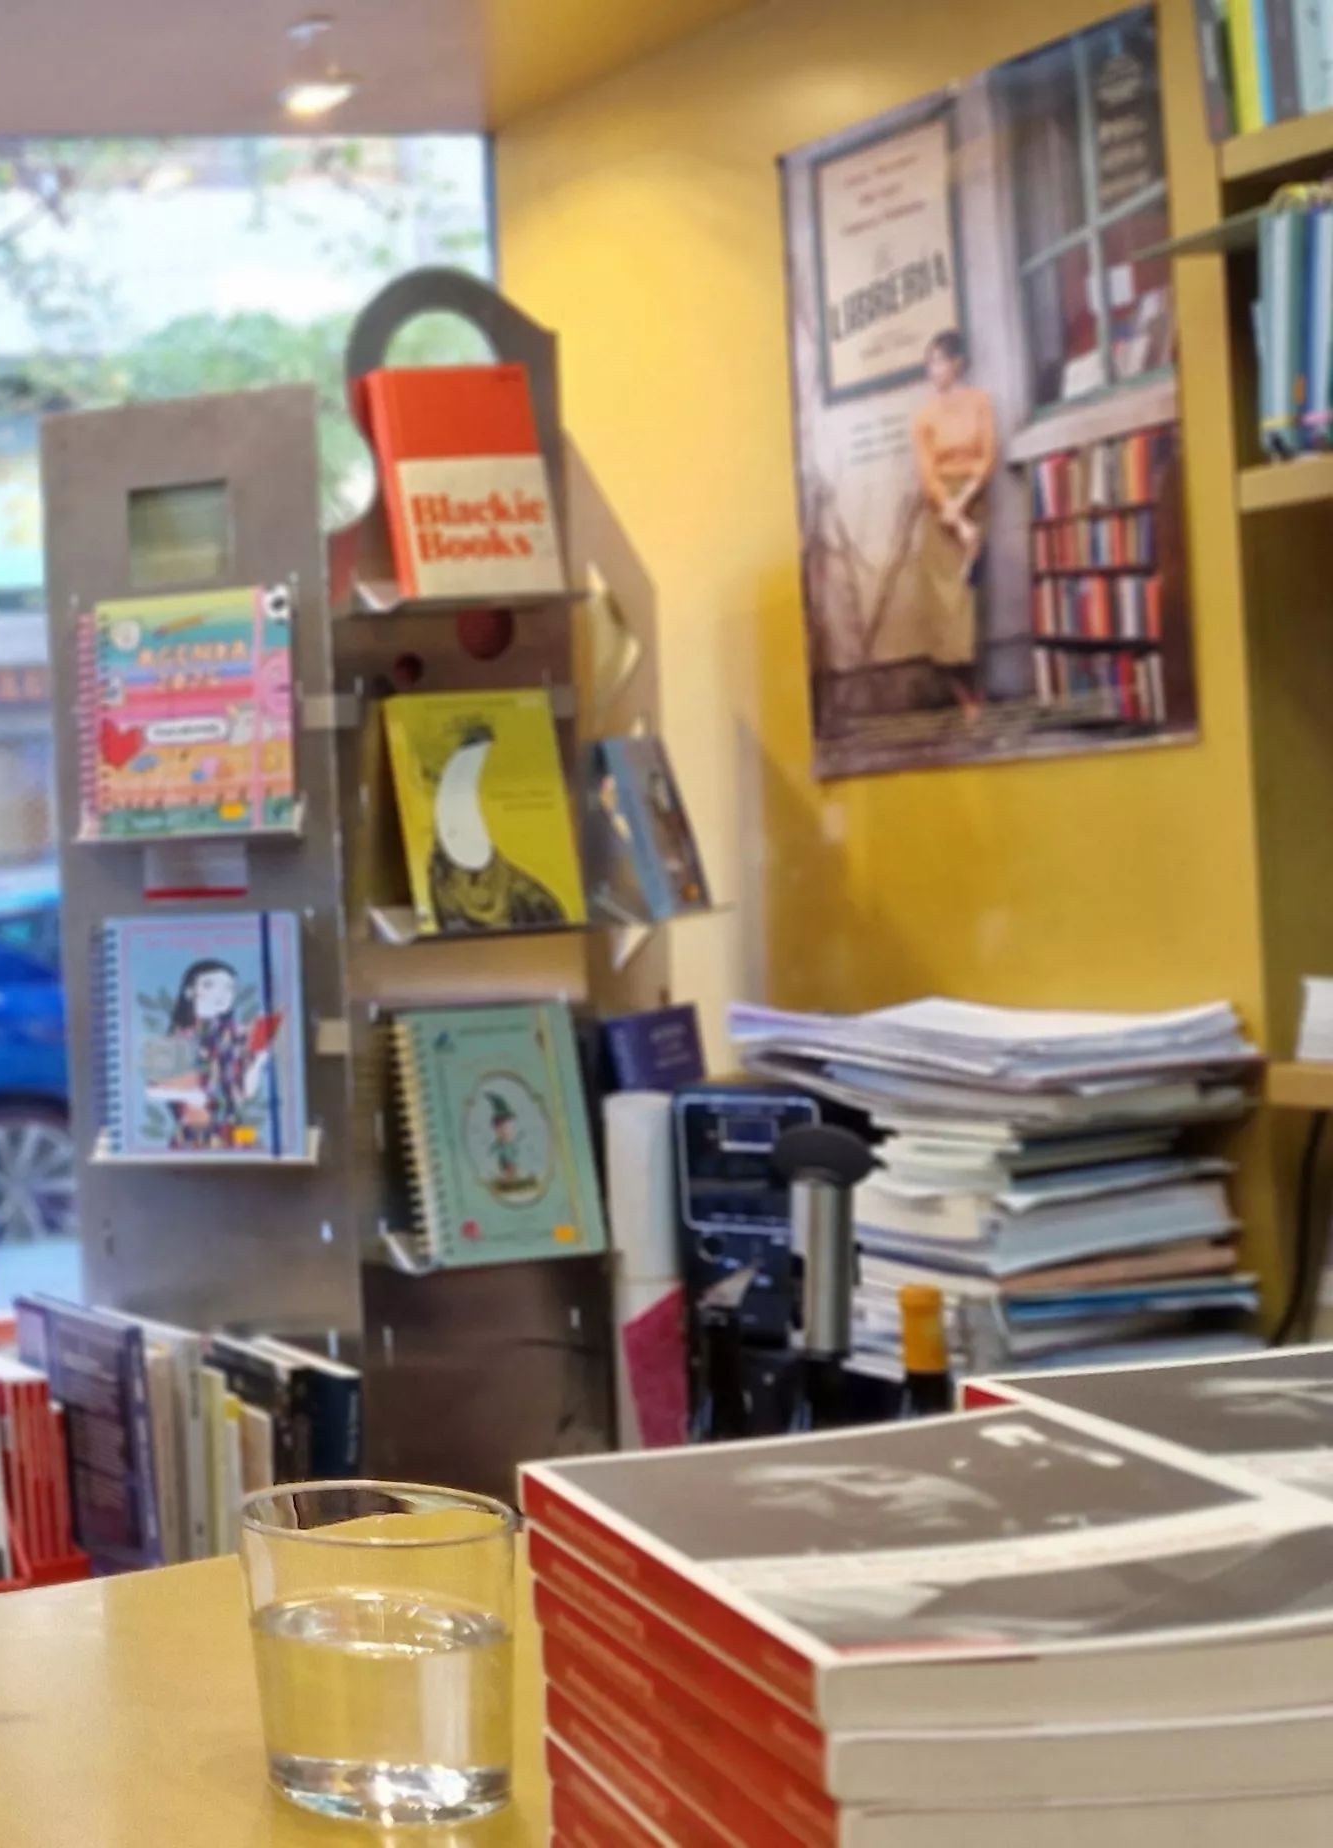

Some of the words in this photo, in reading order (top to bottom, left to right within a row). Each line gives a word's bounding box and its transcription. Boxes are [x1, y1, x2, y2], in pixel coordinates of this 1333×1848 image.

[412, 489, 546, 525] Blackie
[417, 529, 531, 562] Books
[137, 639, 248, 668] AGENDA
